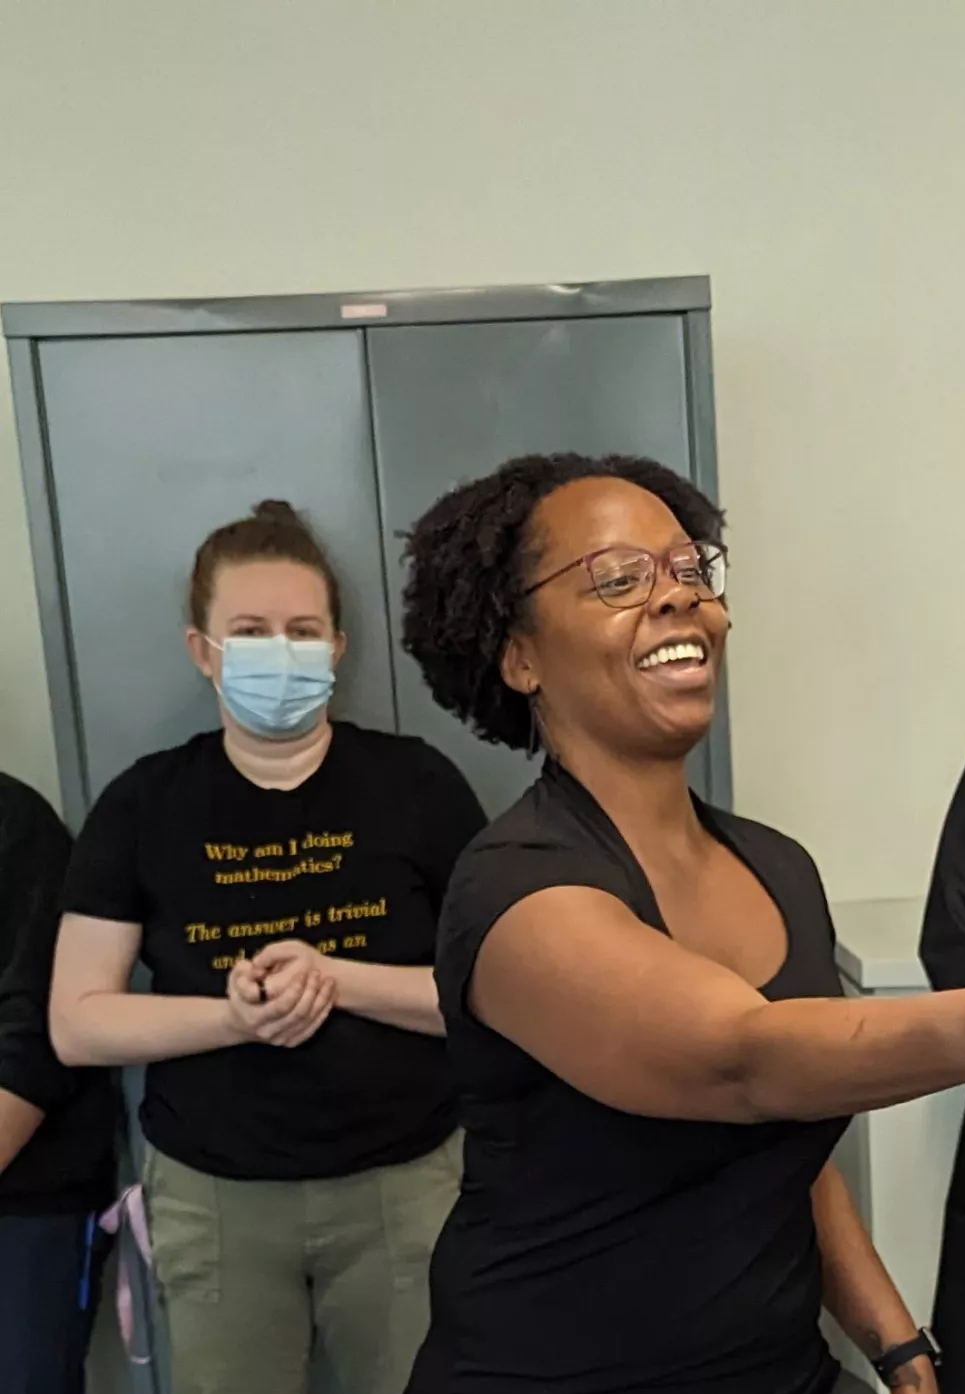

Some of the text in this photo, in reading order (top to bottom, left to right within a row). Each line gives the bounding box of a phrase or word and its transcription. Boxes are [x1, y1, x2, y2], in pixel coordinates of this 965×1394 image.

[204, 831, 354, 861] Why am I doing
[215, 854, 342, 884] mathematics?
[186, 898, 387, 943] The answer is trivial
[343, 934, 367, 948] an
